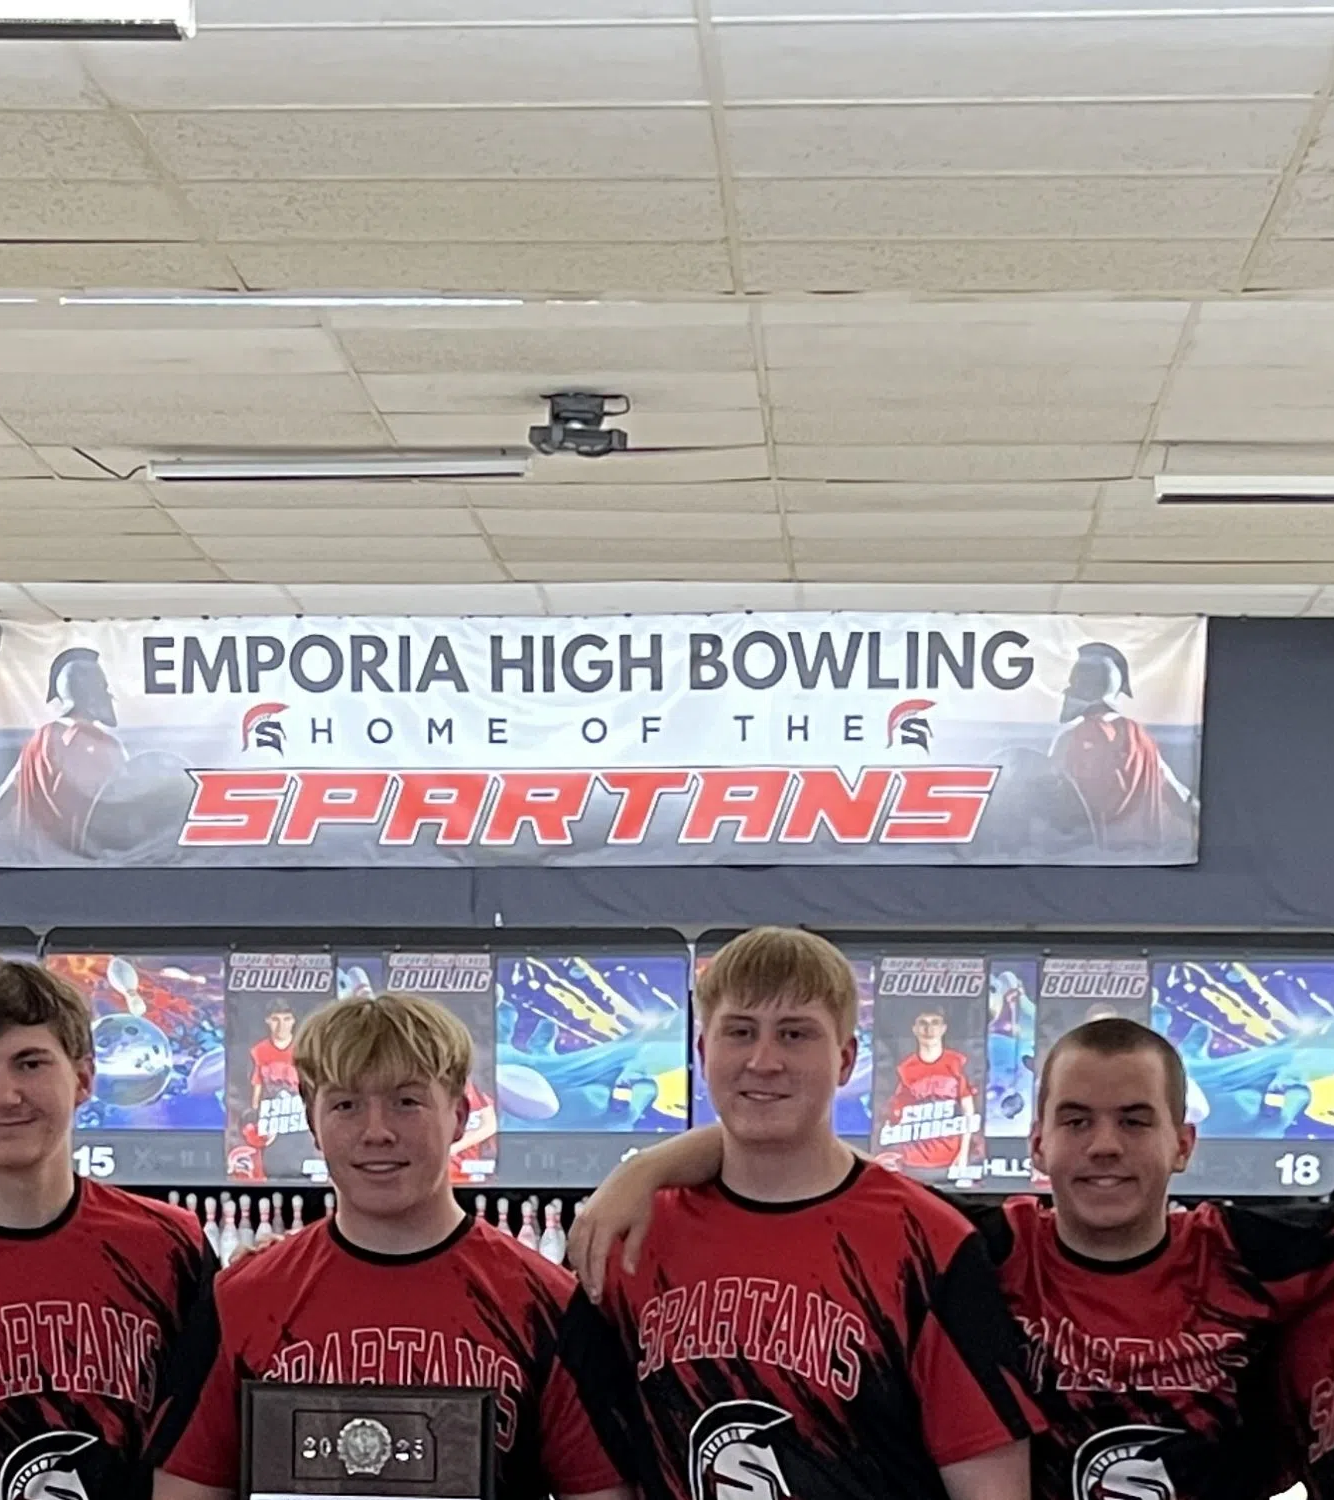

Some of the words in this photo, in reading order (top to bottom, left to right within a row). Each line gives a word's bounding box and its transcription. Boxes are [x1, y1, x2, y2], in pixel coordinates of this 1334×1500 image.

[143, 633, 465, 695] EMPORIA
[491, 632, 663, 693] HIGH
[690, 629, 1034, 692] BOWLING
[310, 716, 509, 745] HOME
[582, 715, 662, 744] OF
[734, 713, 864, 742] THE
[178, 766, 1003, 846] SPARTANS
[229, 968, 331, 991] BOWLING
[388, 968, 491, 991] BOWLING
[879, 972, 984, 996] BOWLING
[1041, 973, 1148, 998] BOWLING
[73, 1145, 116, 1178] 15
[1275, 1153, 1320, 1185] 18
[637, 1276, 866, 1401] SPARTANS
[302, 1437, 332, 1459] 20
[395, 1438, 425, 1461] 25
